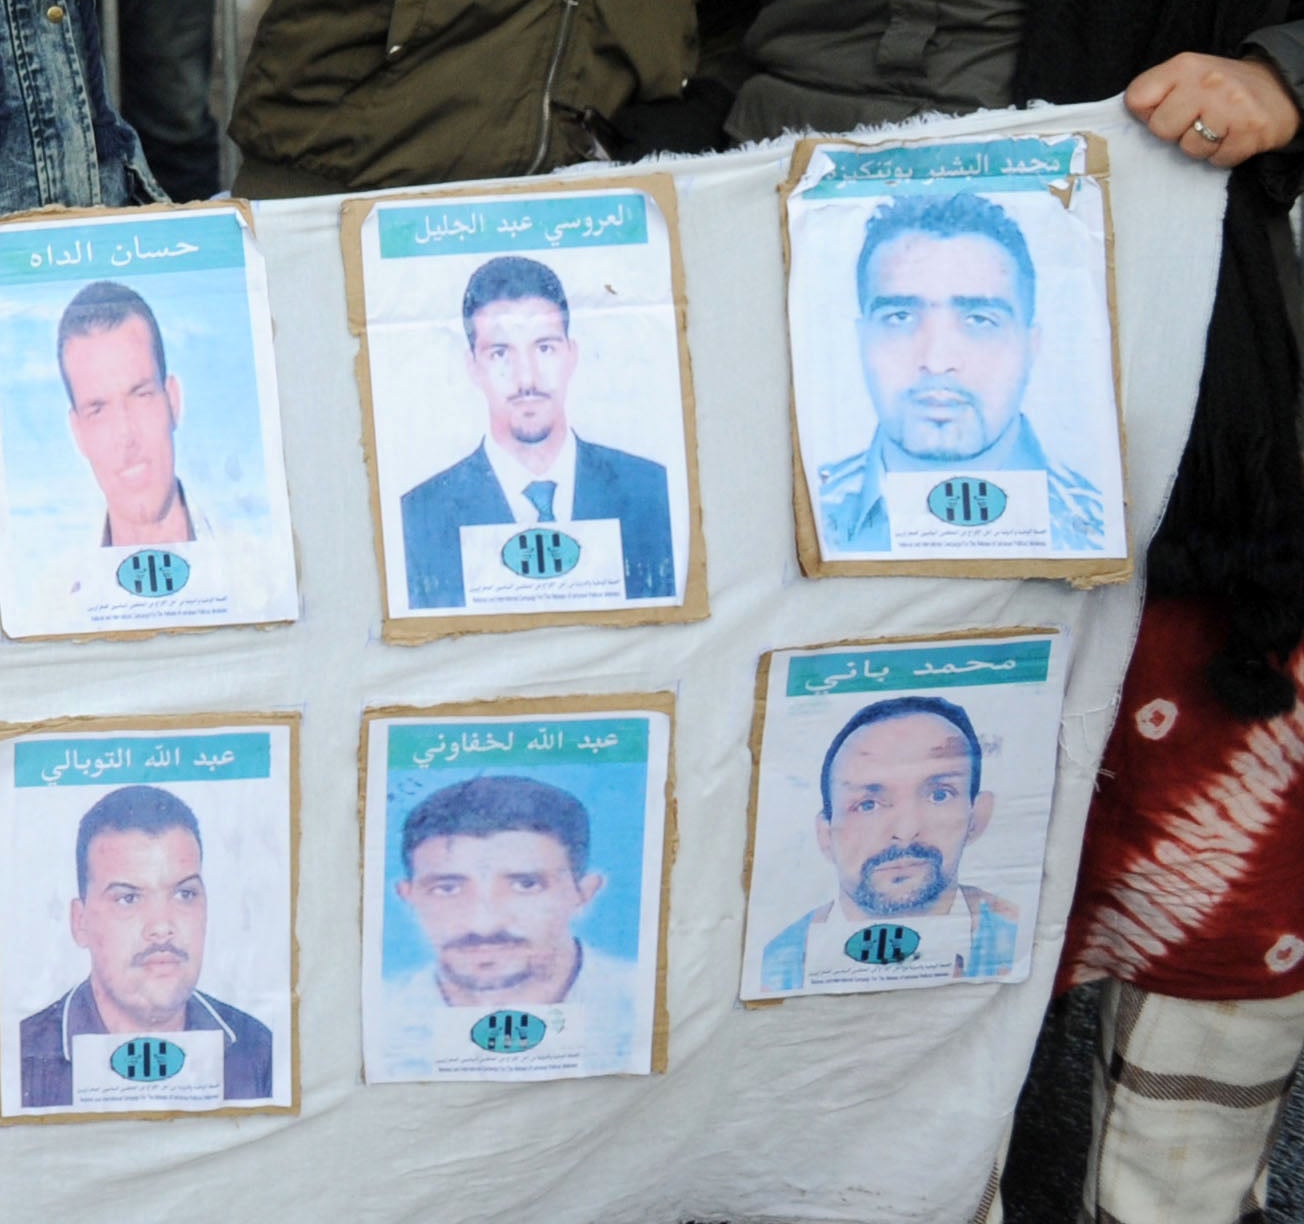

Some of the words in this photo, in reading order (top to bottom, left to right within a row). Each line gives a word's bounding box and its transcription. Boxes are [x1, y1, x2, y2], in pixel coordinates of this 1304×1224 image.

[1001, 156, 1061, 174] محمد
[414, 212, 484, 246] الجليل
[496, 214, 533, 238] عبد
[30, 238, 94, 269] الداه
[110, 234, 200, 268] حسان
[804, 658, 892, 697] باني
[912, 656, 1018, 678] محمد
[412, 730, 515, 771] لخفاوني
[526, 726, 564, 752] الله
[576, 731, 620, 755] عبد
[41, 747, 134, 788] التوبالي
[143, 744, 181, 769] الله
[192, 748, 236, 772] عبد
